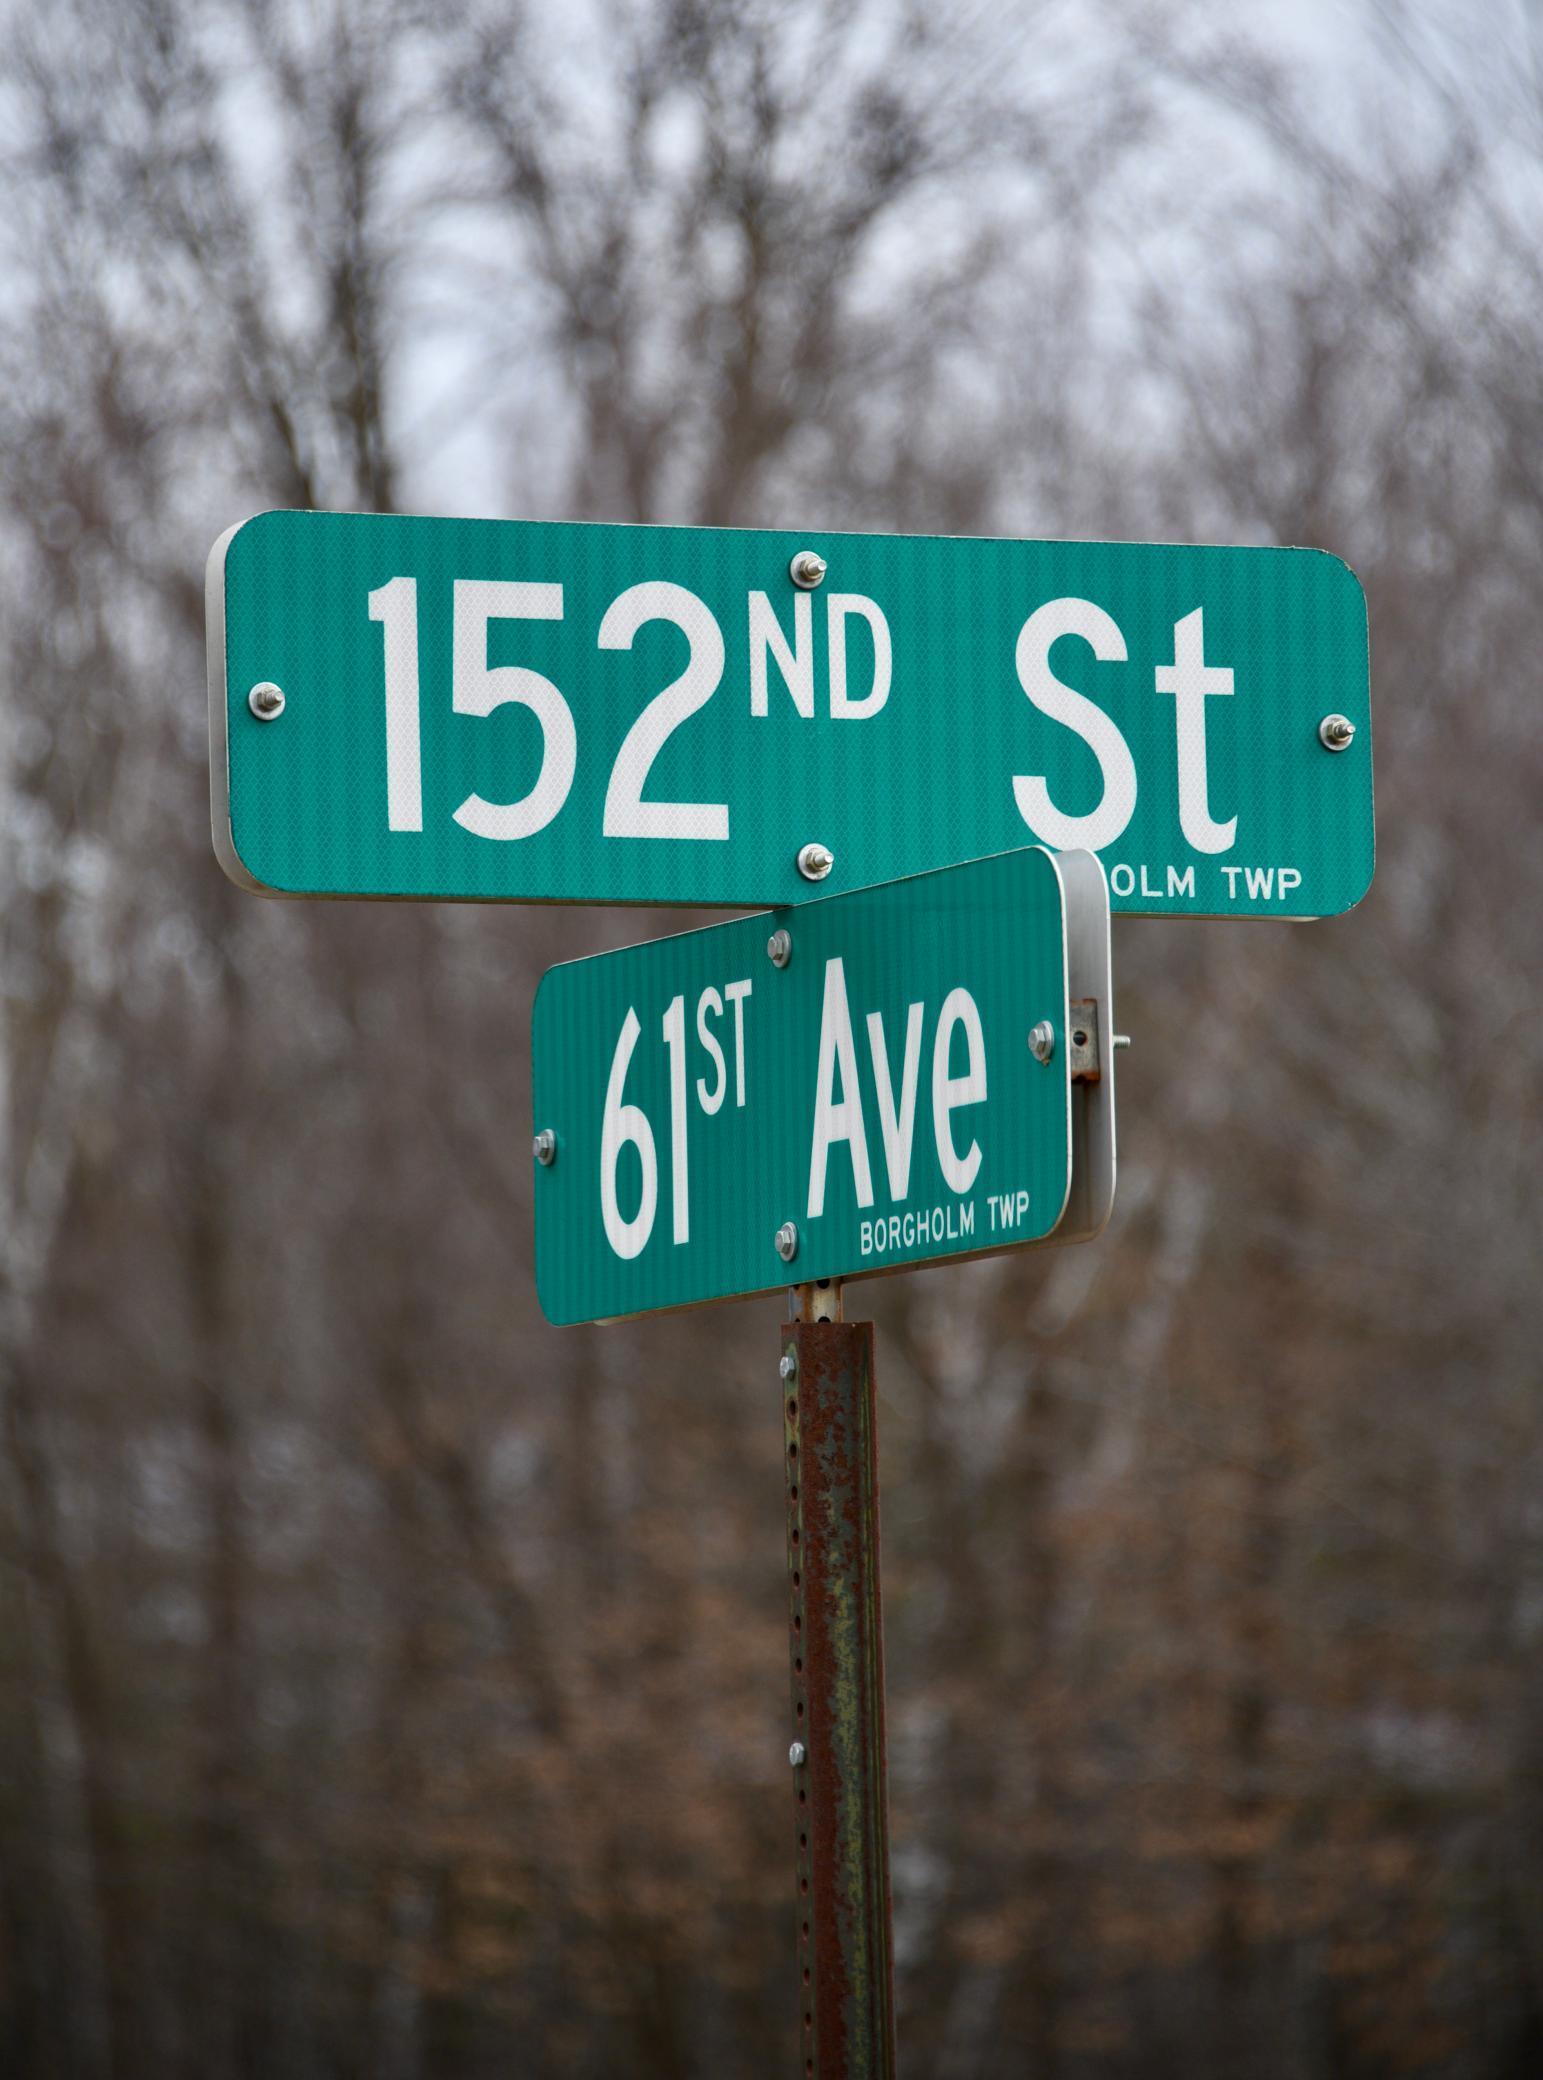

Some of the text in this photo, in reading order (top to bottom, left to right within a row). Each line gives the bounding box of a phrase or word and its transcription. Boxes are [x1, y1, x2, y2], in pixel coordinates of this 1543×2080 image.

[367, 576, 1238, 855] 152ND St
[1106, 863, 1302, 900] OLM TWP
[600, 957, 988, 1260] 61ST Ave
[860, 1190, 1030, 1256] BORGHOLM TWP
